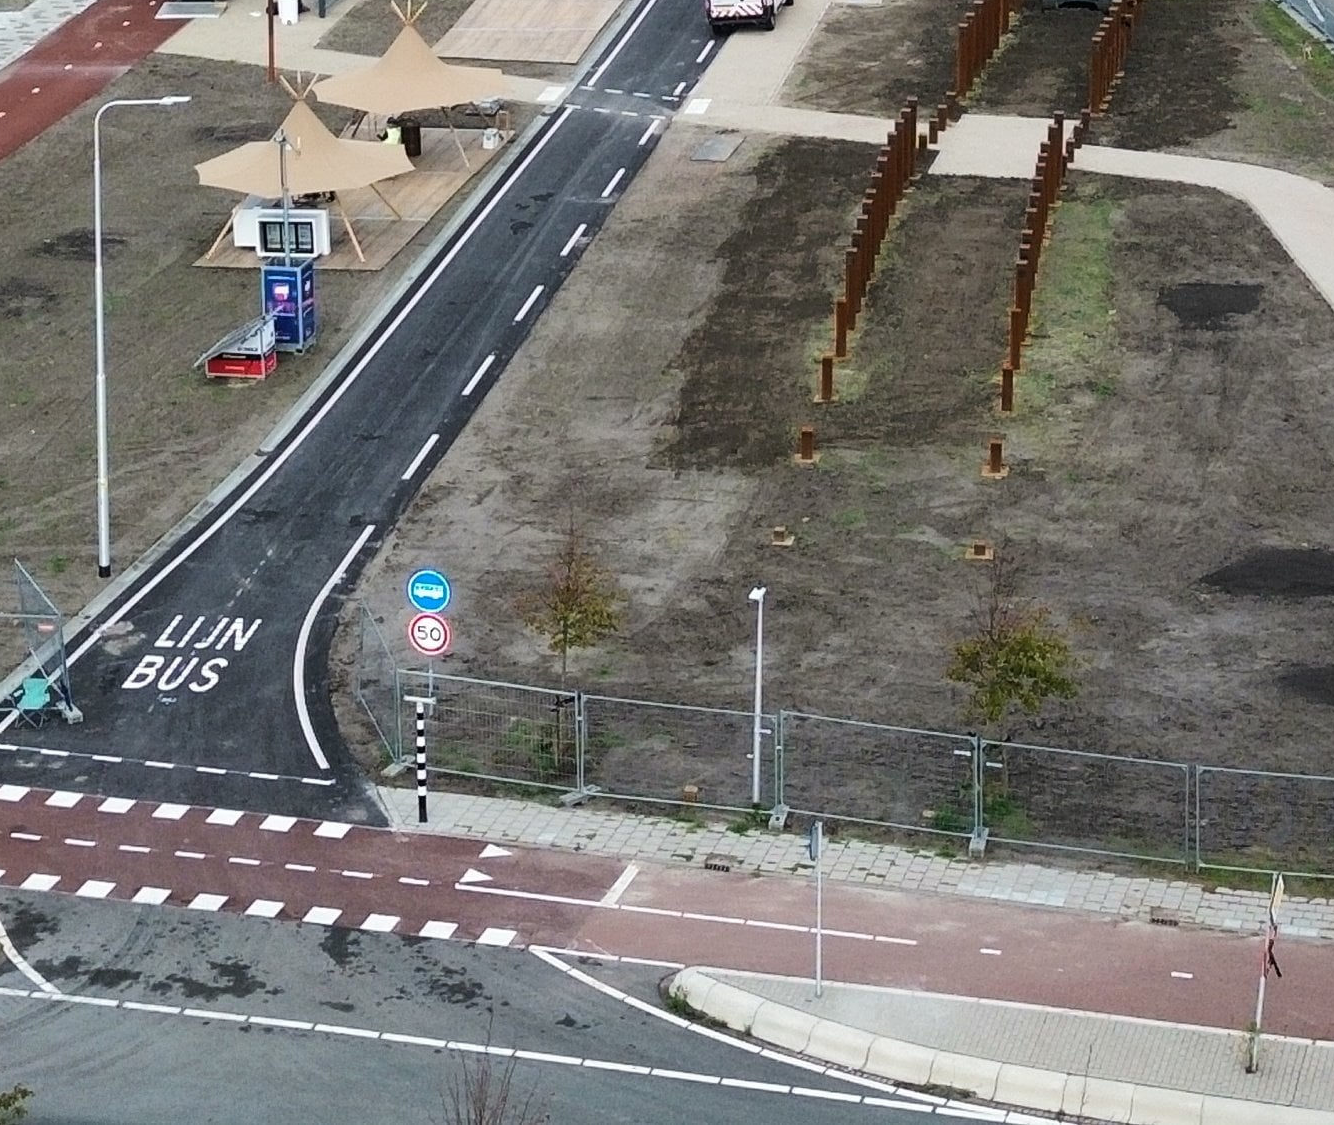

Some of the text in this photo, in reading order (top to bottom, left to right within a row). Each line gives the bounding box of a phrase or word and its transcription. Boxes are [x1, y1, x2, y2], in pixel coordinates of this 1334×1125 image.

[154, 614, 263, 651] LIJN
[417, 625, 441, 642] 50
[121, 654, 229, 692] BUS
